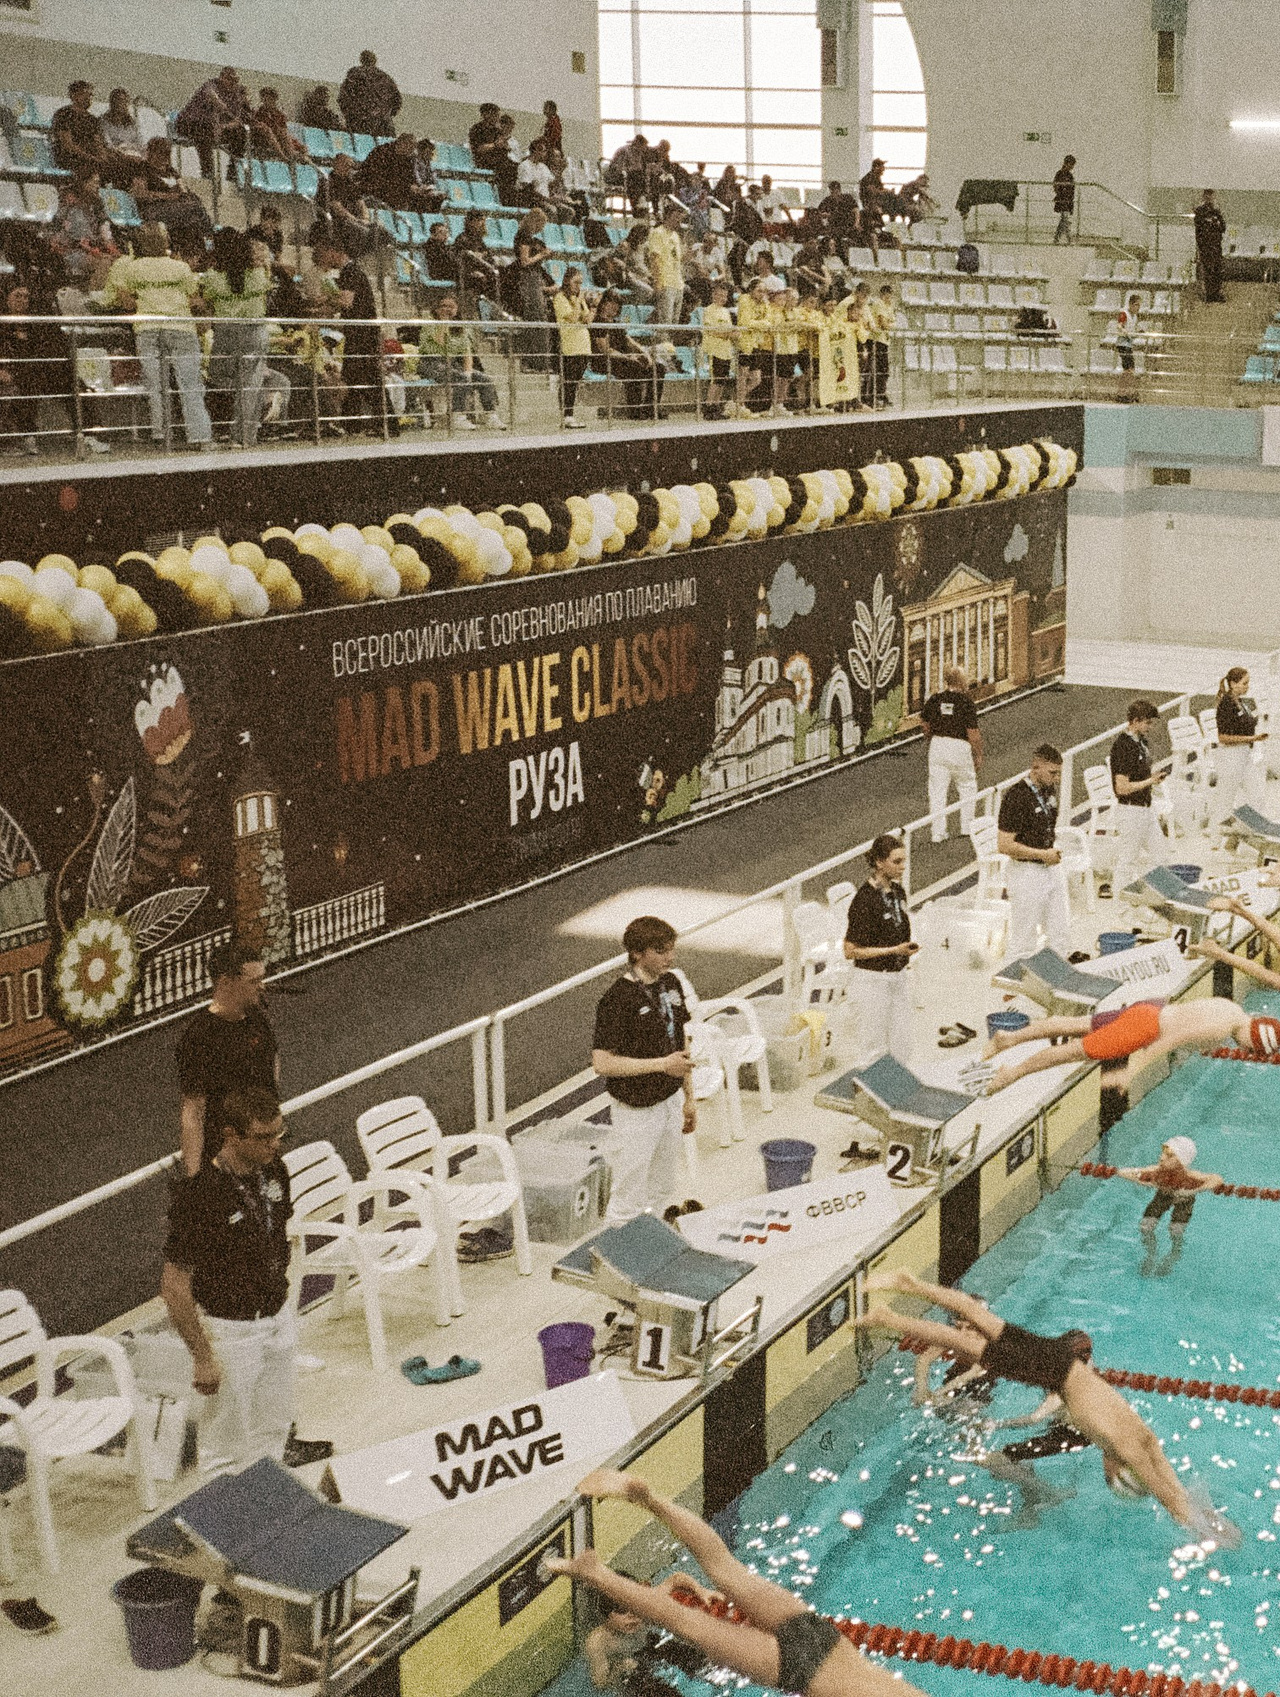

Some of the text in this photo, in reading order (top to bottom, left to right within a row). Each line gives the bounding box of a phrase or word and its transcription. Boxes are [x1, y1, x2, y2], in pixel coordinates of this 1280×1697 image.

[332, 576, 698, 678] ВСЕРОССИЙСКИЕ СОРЕВНОВАНИЯ ПО ПЛАВАНИЮ
[336, 622, 700, 783] MAD WAVE CLASSIC
[508, 741, 585, 827] РУЗА
[886, 1144, 911, 1182] 2
[641, 1326, 666, 1372] 1
[433, 1403, 544, 1463] MAD
[429, 1431, 565, 1501] WAVE
[246, 1617, 281, 1676] 0
